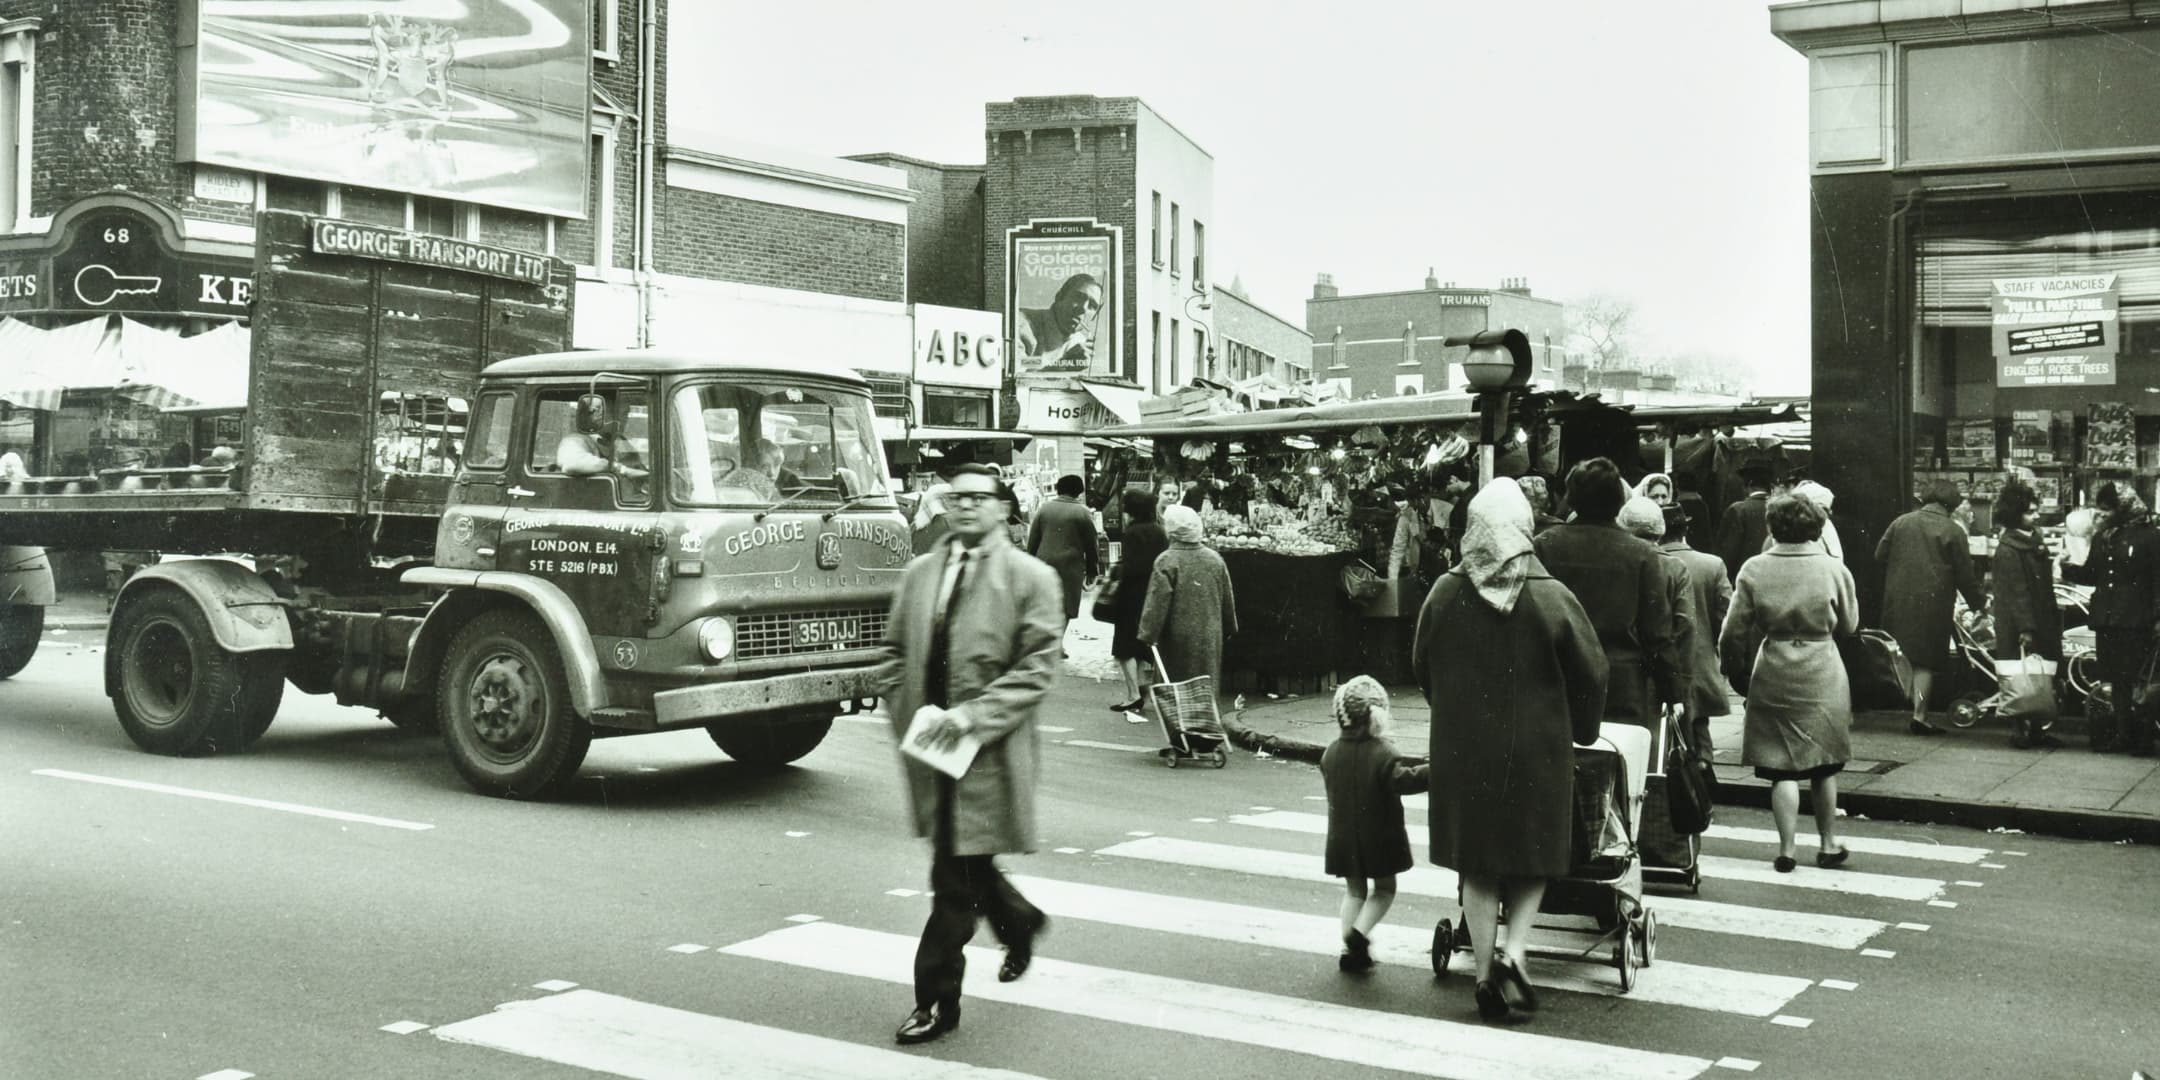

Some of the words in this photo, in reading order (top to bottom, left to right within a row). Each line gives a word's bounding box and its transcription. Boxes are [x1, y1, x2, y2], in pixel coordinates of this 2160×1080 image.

[103, 227, 130, 244] 68
[1041, 225, 1085, 233] CHURCHILL
[321, 224, 400, 256] GEORGE
[407, 234, 510, 273] TRANSPORT
[513, 254, 545, 280] LTD
[1023, 251, 1103, 265] Golden
[2003, 281, 2036, 294] STAFF
[2041, 278, 2106, 292] VACANCIES
[926, 329, 996, 369] ABC
[2003, 364, 2045, 377] ENGLISH
[2048, 363, 2075, 375] ROSE
[2078, 362, 2110, 374] TREES
[724, 520, 806, 556] GEORGE
[835, 518, 910, 561] TRANSPORT
[529, 559, 554, 572] STE
[560, 561, 585, 574] 5216
[586, 561, 619, 577] (PBX)
[799, 621, 826, 643] 351
[827, 619, 857, 641] DJJ
[616, 648, 634, 662] 53
